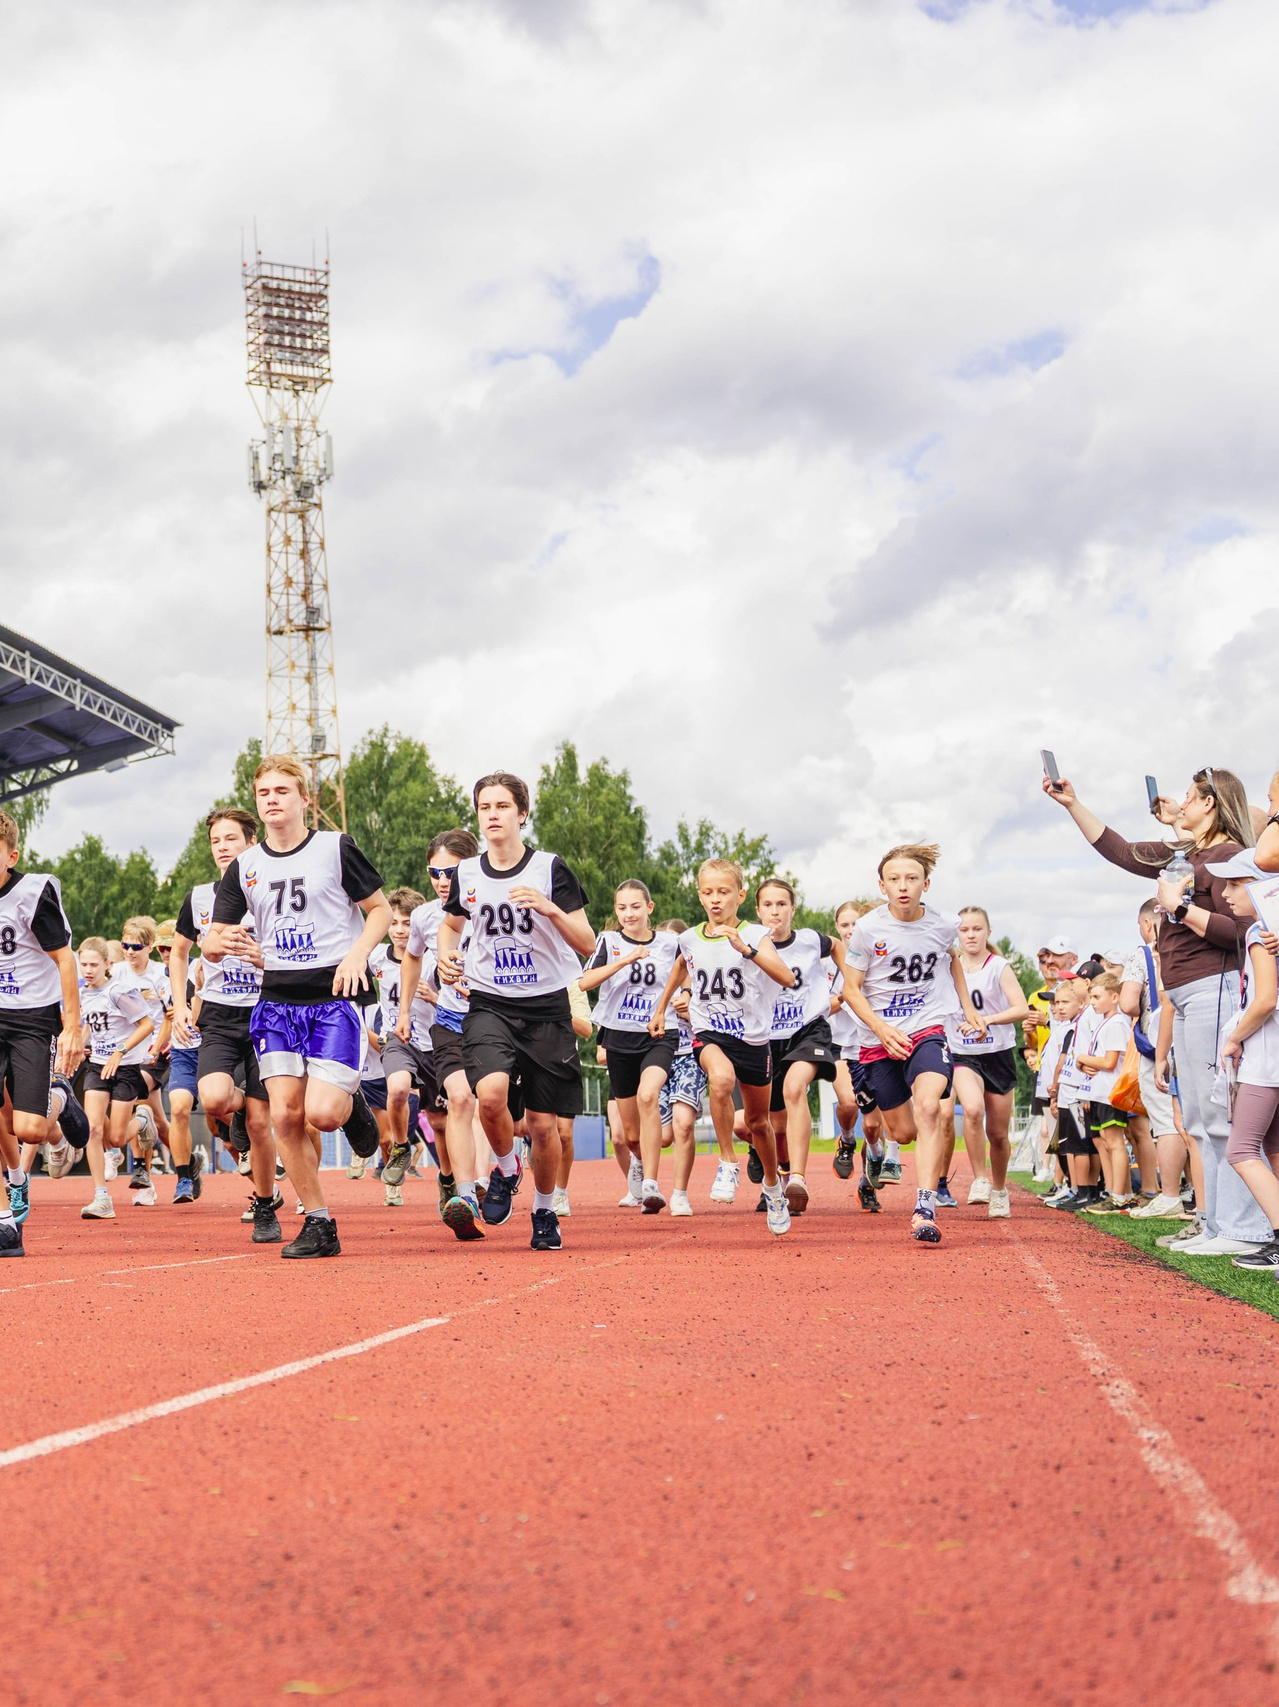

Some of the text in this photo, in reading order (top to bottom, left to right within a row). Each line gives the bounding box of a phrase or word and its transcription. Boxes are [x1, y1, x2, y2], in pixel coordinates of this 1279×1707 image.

[269, 877, 307, 915] 75
[480, 902, 534, 935] 293
[496, 975, 535, 984] ТИХВИН
[630, 961, 656, 986] 88
[888, 951, 937, 983] 262
[697, 967, 745, 1001] 243
[86, 1012, 110, 1032] 137
